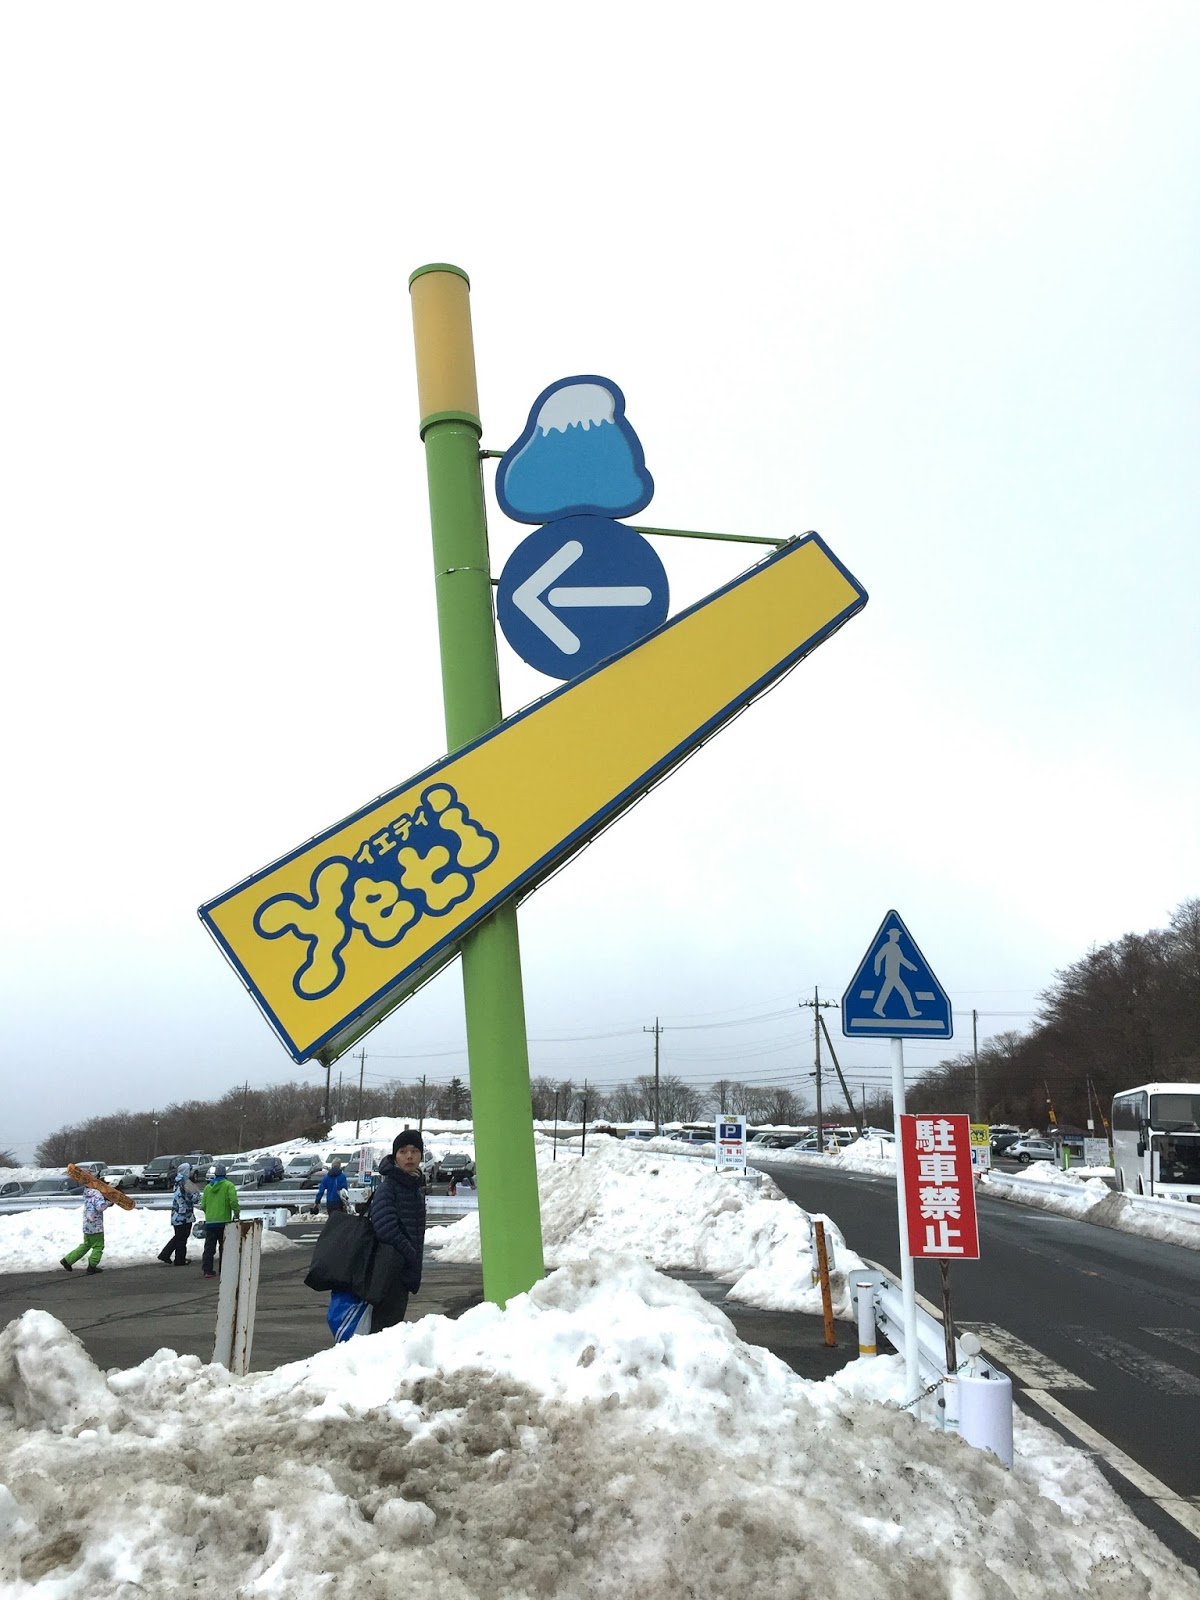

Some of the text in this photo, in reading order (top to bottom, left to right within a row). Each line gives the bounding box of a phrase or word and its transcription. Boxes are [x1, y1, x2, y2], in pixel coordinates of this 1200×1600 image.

[356, 810, 429, 865] イエティ
[254, 783, 499, 1000] Yeti
[725, 1125, 736, 1138] P
[915, 1118, 964, 1254] 駐車禁止
